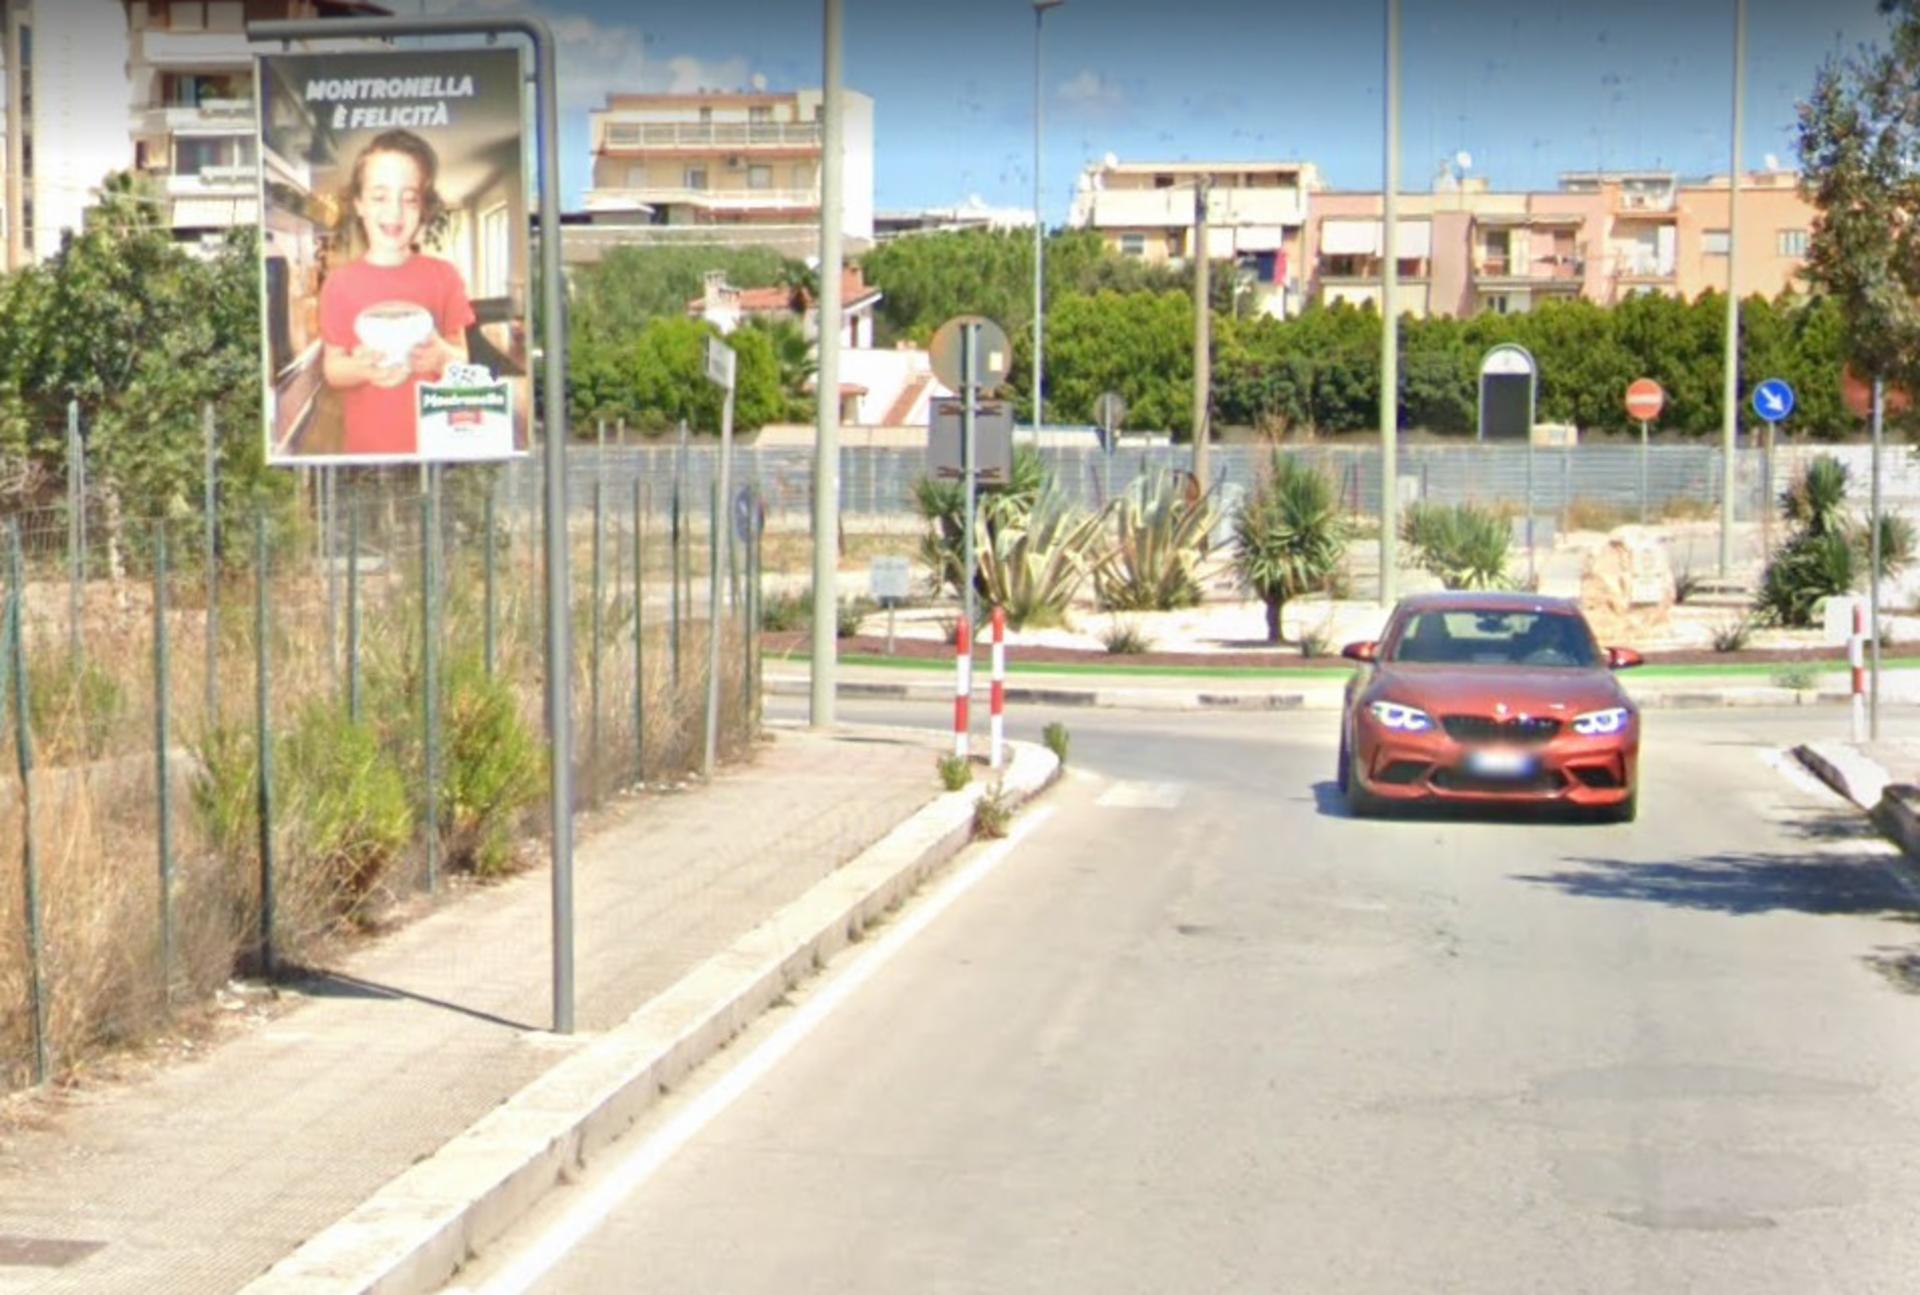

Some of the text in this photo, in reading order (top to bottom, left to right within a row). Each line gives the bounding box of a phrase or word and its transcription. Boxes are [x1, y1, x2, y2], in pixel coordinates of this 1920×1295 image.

[305, 76, 474, 101] MONTRONELLA
[332, 101, 449, 129] È FELICITÀ
